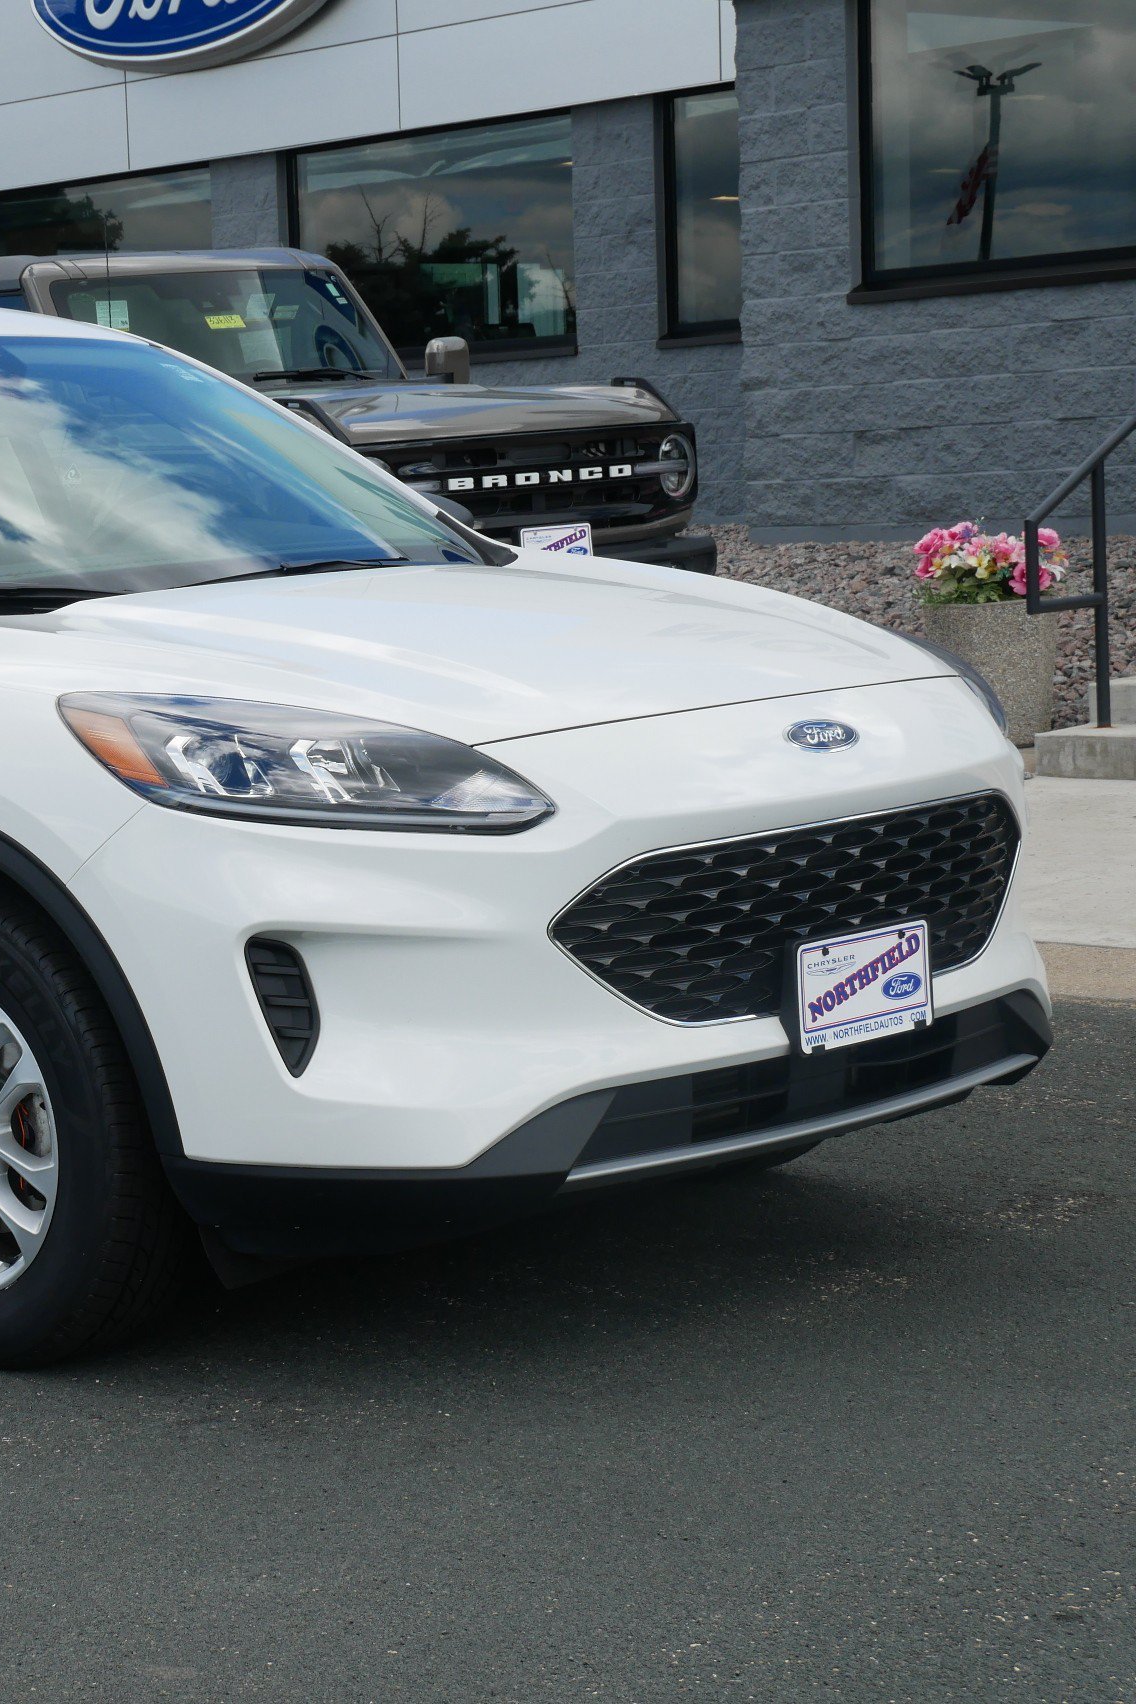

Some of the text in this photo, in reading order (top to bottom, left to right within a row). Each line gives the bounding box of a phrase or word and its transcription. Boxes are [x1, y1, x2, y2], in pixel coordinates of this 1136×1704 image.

[448, 464, 632, 491] BRONCO
[803, 724, 845, 744] Ford
[807, 954, 855, 970] CHRYSLER
[807, 933, 921, 1023] NORTHFIELD
[889, 976, 914, 995] Ford
[833, 1015, 904, 1040] NORTHFIELDAUTOS
